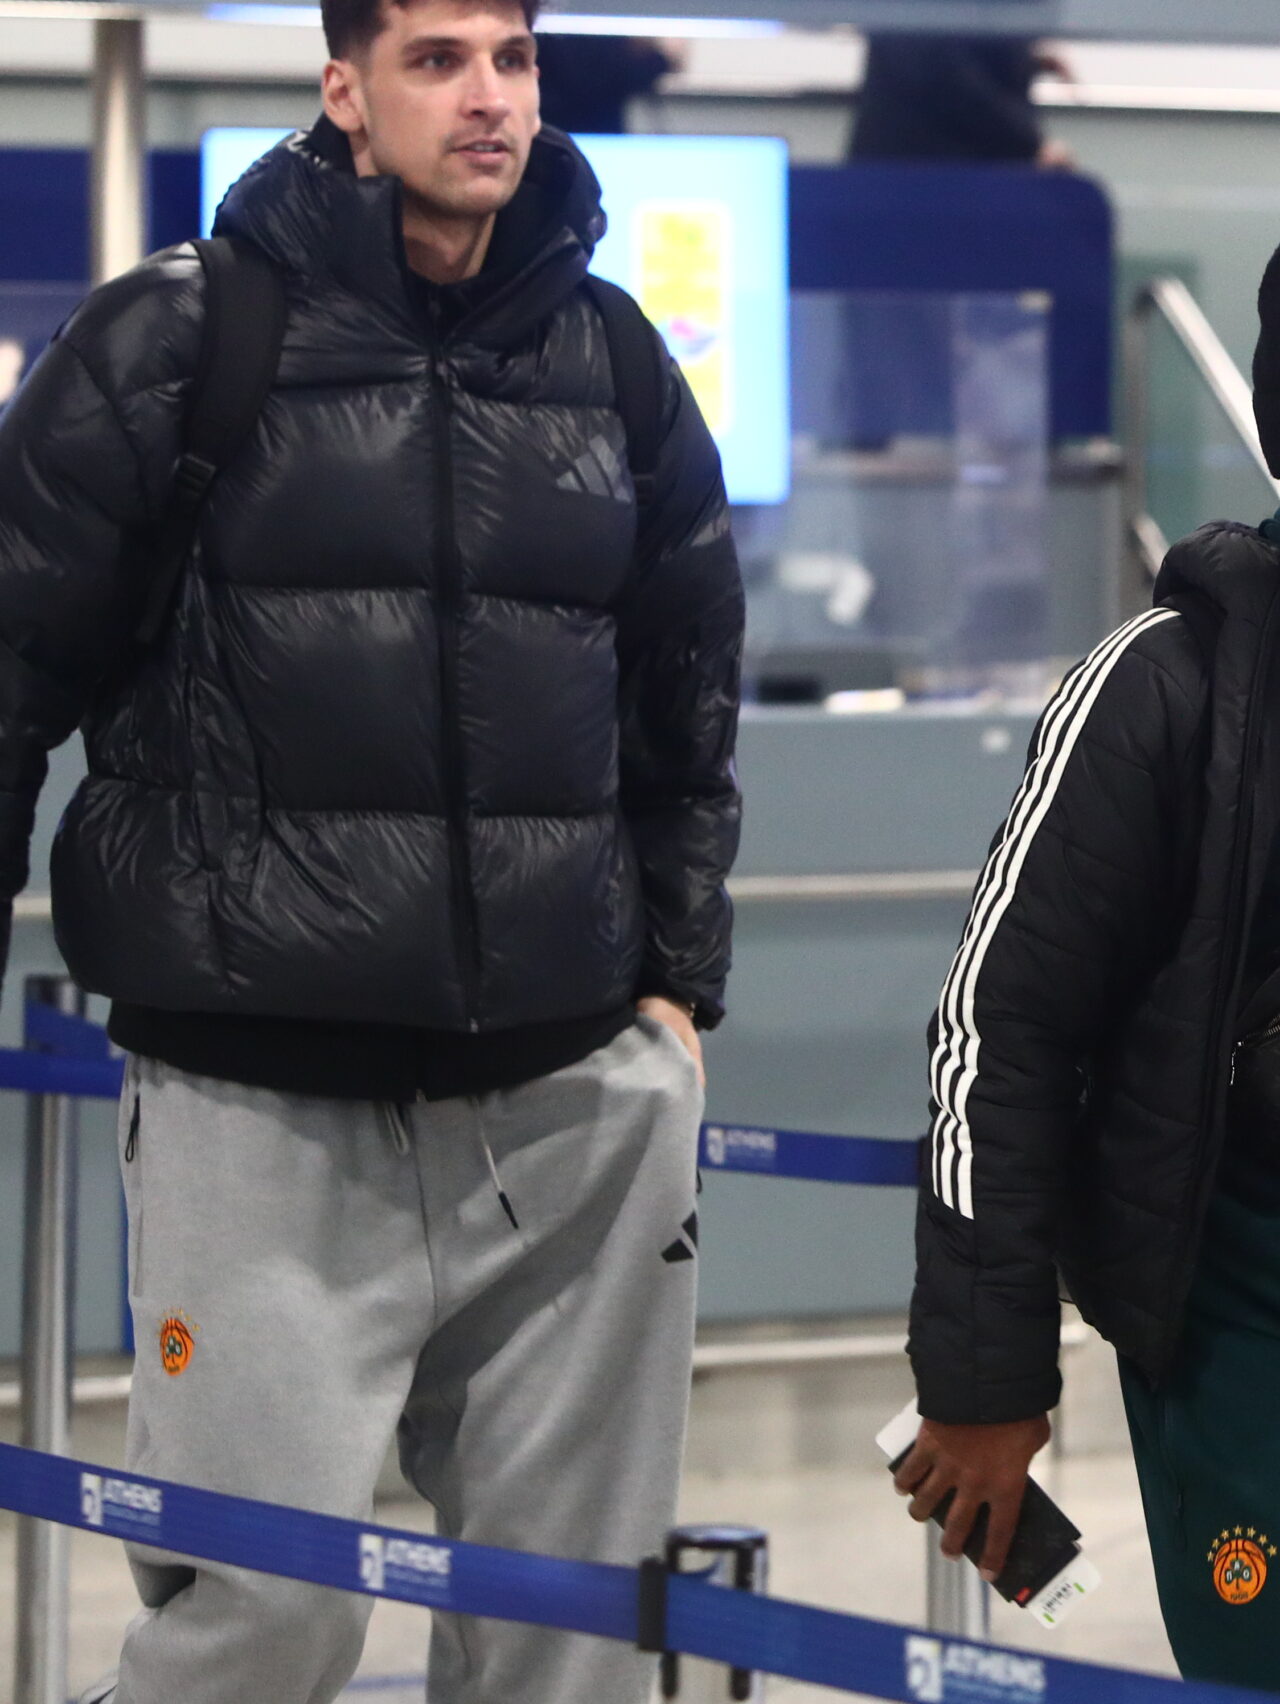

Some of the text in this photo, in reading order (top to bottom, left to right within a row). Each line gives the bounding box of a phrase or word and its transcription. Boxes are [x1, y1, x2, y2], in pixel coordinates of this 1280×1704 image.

[103, 1478, 163, 1514] ATHENS
[384, 1537, 452, 1575] ATHENS
[945, 1642, 1046, 1693] ATHENS
